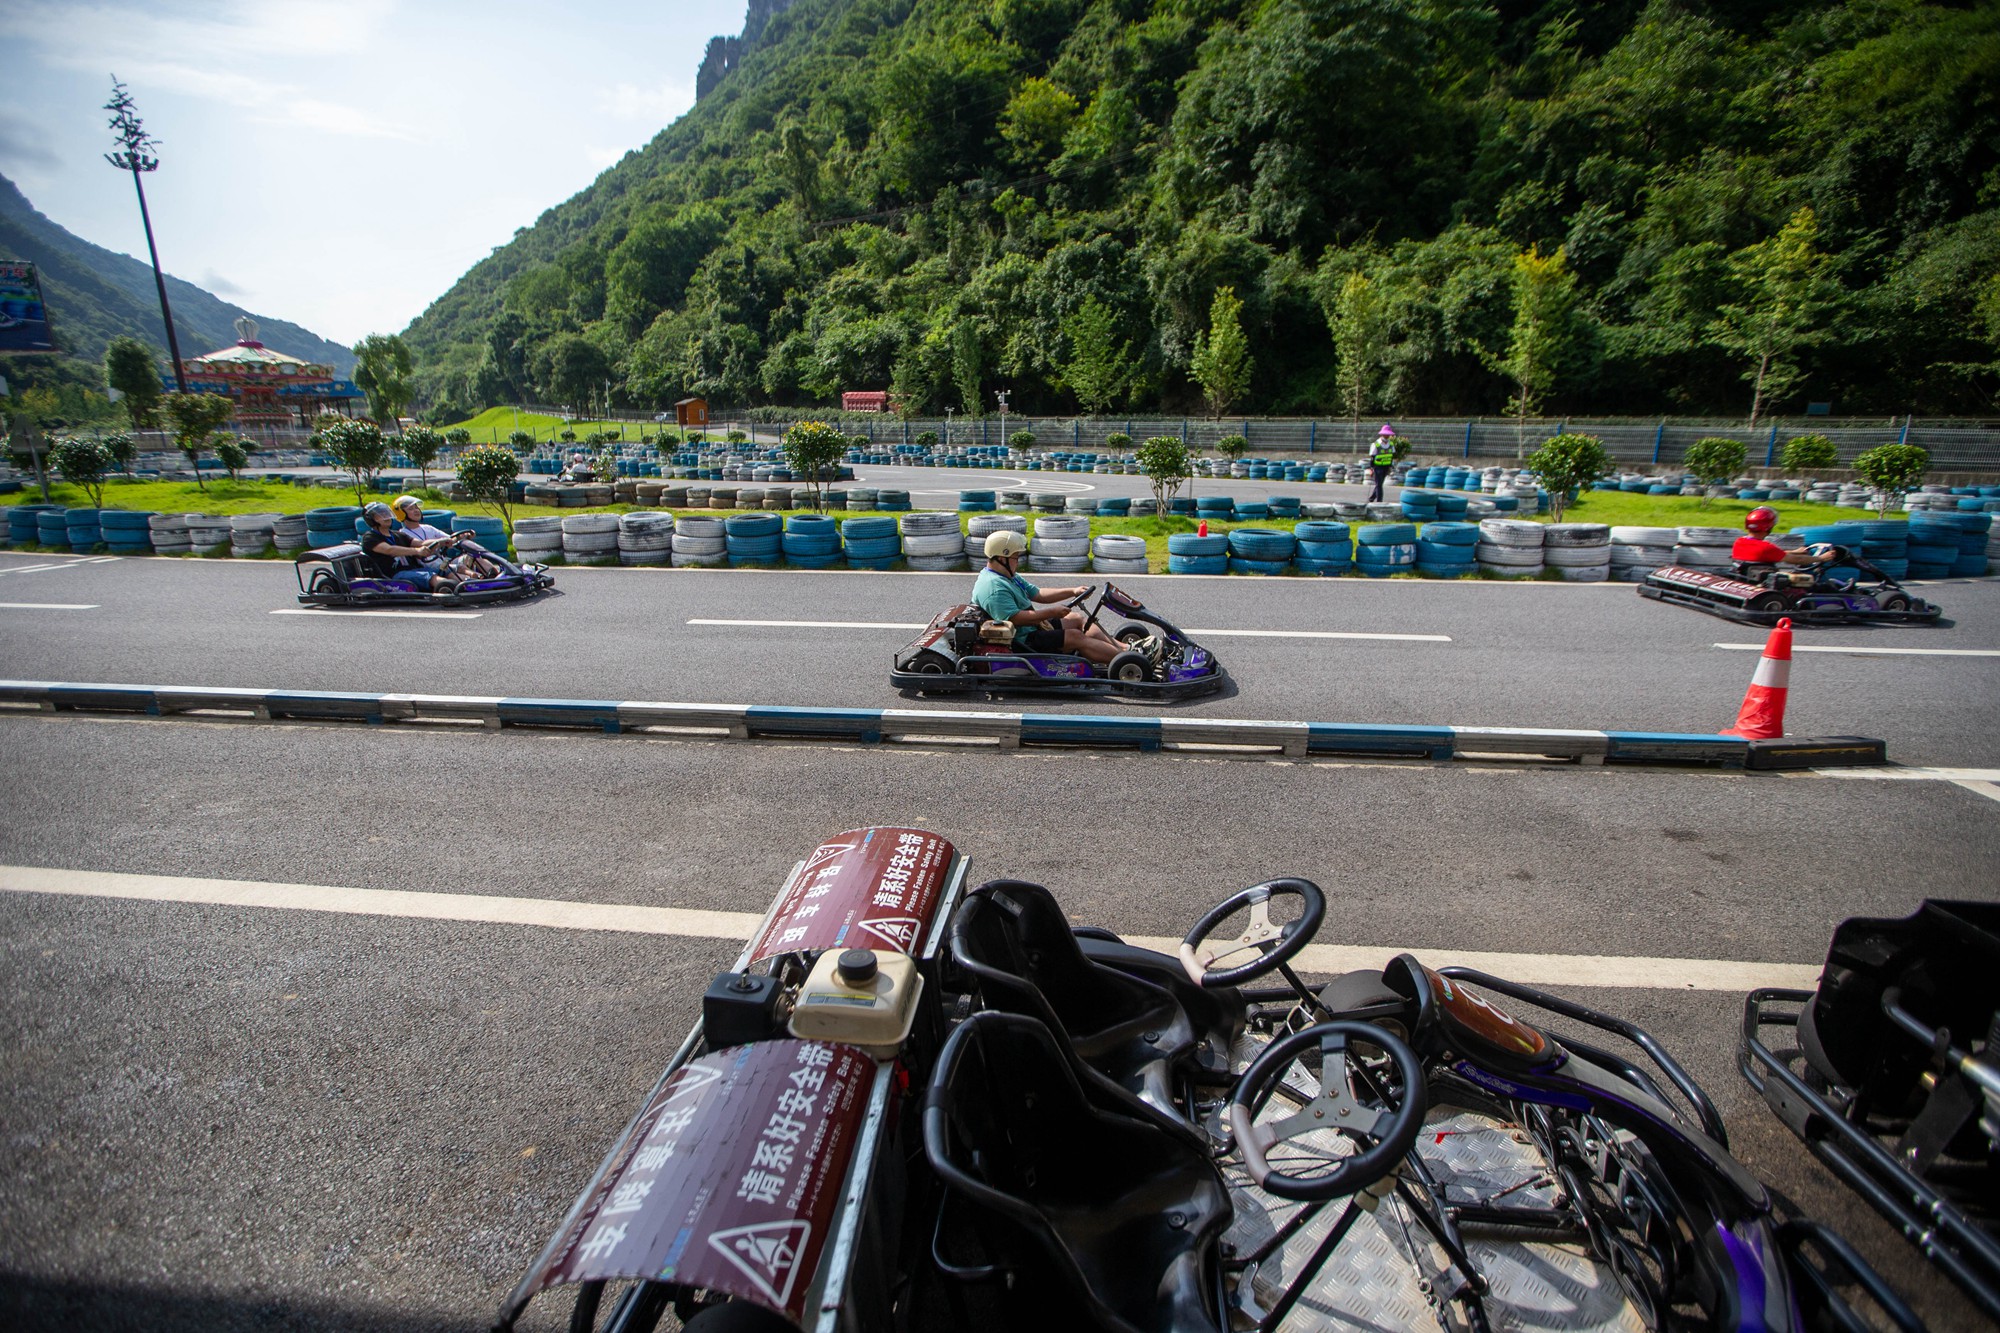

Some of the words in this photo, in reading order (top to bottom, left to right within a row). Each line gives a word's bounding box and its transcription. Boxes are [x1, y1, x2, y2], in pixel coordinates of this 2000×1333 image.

[872, 833, 924, 909] 请系好安全带
[912, 869, 927, 889] Fasten
[920, 851, 935, 869] Safety
[927, 838, 938, 850] Belt
[776, 865, 844, 944] 保持车距
[905, 890, 919, 912] Please
[737, 1043, 834, 1205] 请系好安全带
[787, 1164, 814, 1211] Please
[804, 1118, 830, 1161] Fasten
[822, 1079, 846, 1116] Safety
[835, 1054, 853, 1077] Belt
[579, 1105, 698, 1265] 注意刹车
